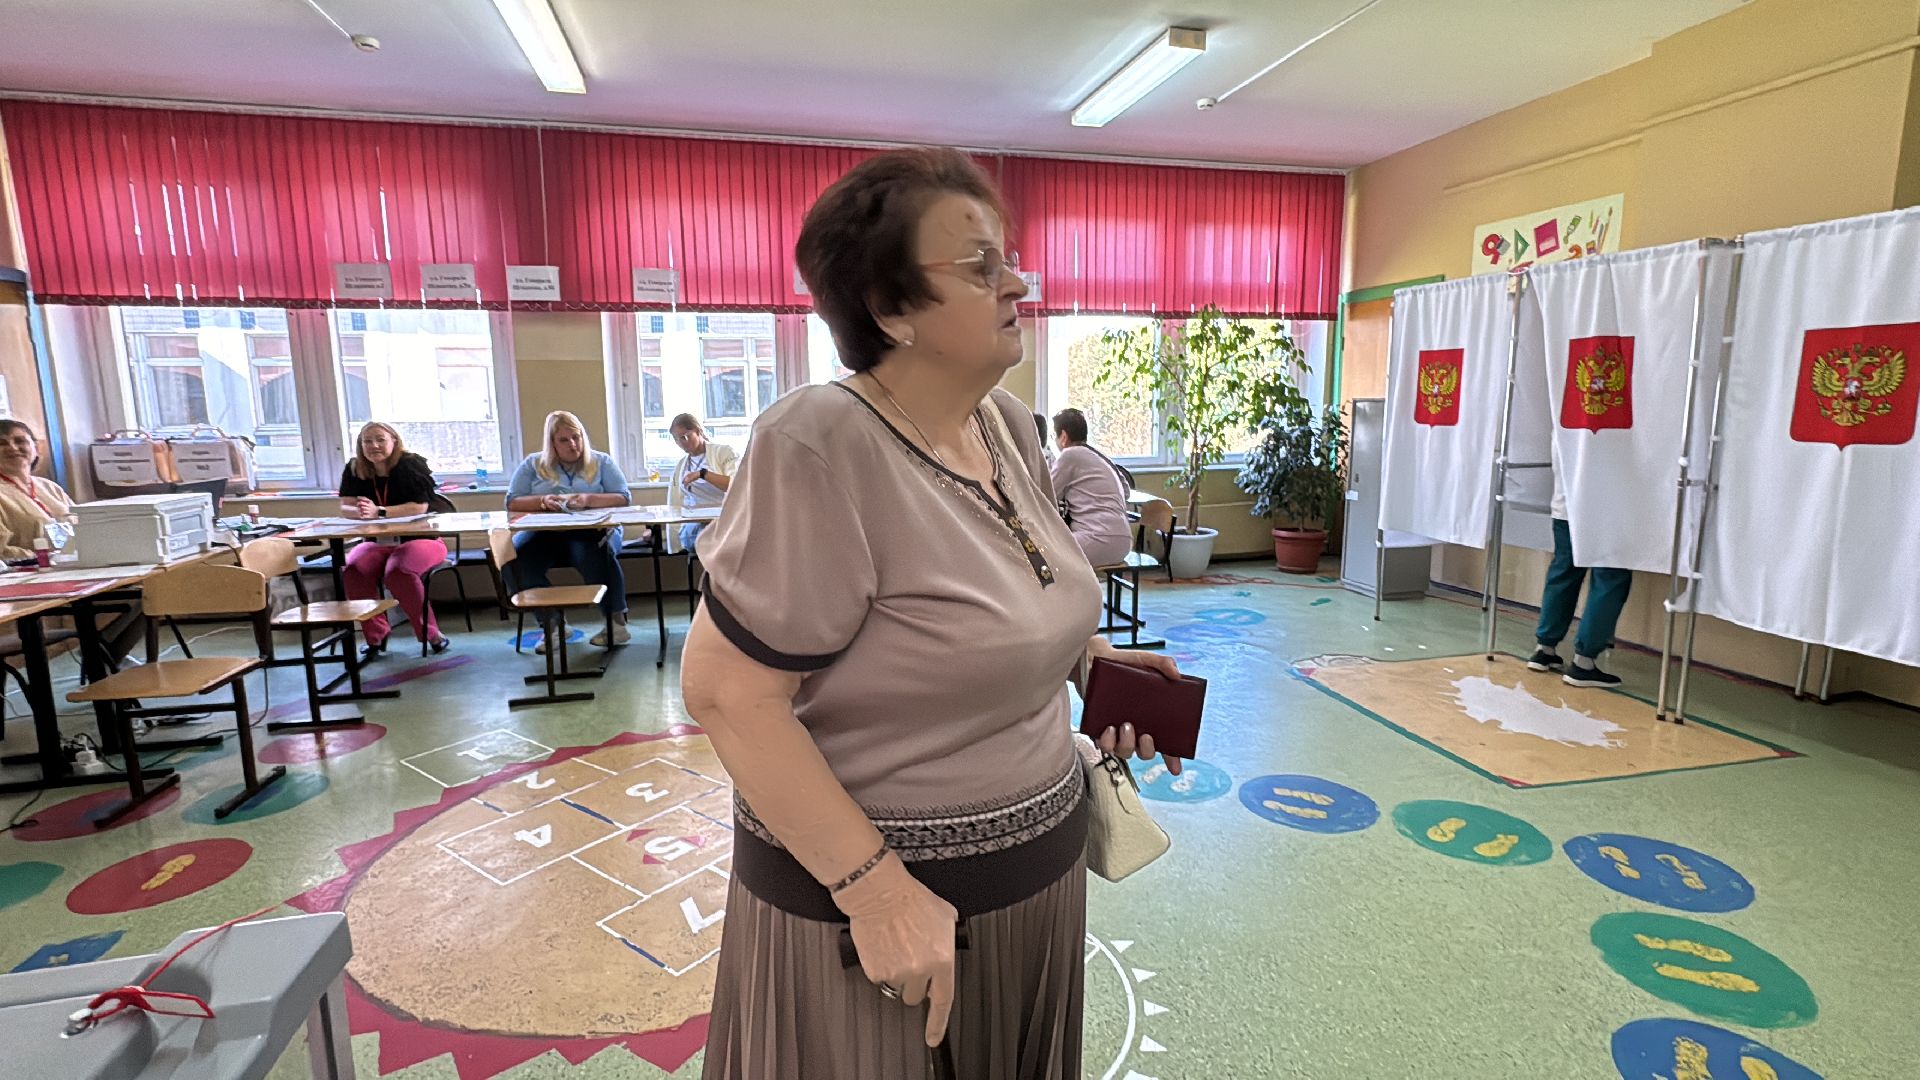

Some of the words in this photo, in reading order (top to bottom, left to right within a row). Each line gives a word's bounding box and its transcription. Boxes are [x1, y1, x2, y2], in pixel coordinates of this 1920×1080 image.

[456, 747, 497, 762] 1
[513, 771, 556, 790] 2
[625, 782, 670, 803] 3
[513, 823, 553, 848] 4
[644, 835, 696, 862] 5
